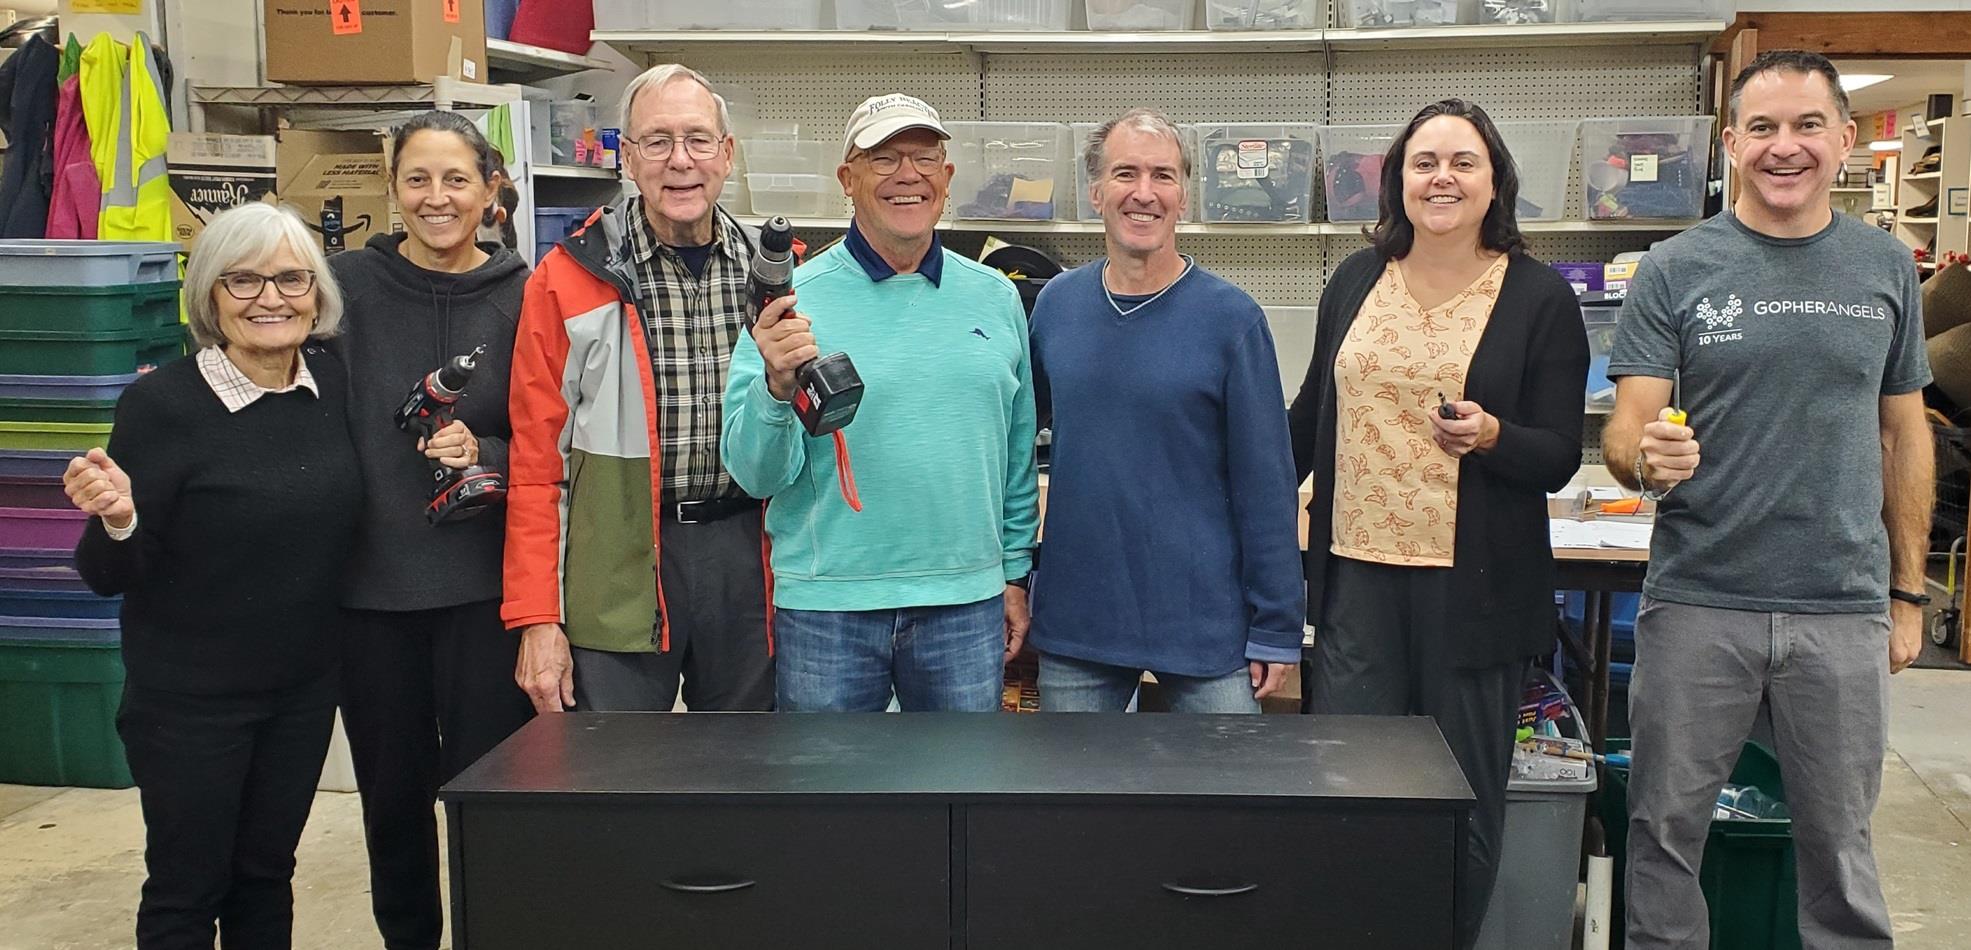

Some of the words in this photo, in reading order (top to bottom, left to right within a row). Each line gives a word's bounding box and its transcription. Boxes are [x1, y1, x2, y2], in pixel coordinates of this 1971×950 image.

[276, 8, 298, 16] Thank
[299, 9, 313, 17] you
[314, 8, 325, 16] for
[869, 97, 896, 115] FOLLY
[190, 181, 249, 208] Rainier
[1604, 291, 1627, 300] BLOC
[1754, 301, 1885, 320] GOPHERANGELS
[1698, 335, 1711, 345] 10
[1713, 332, 1743, 343] YEARS
